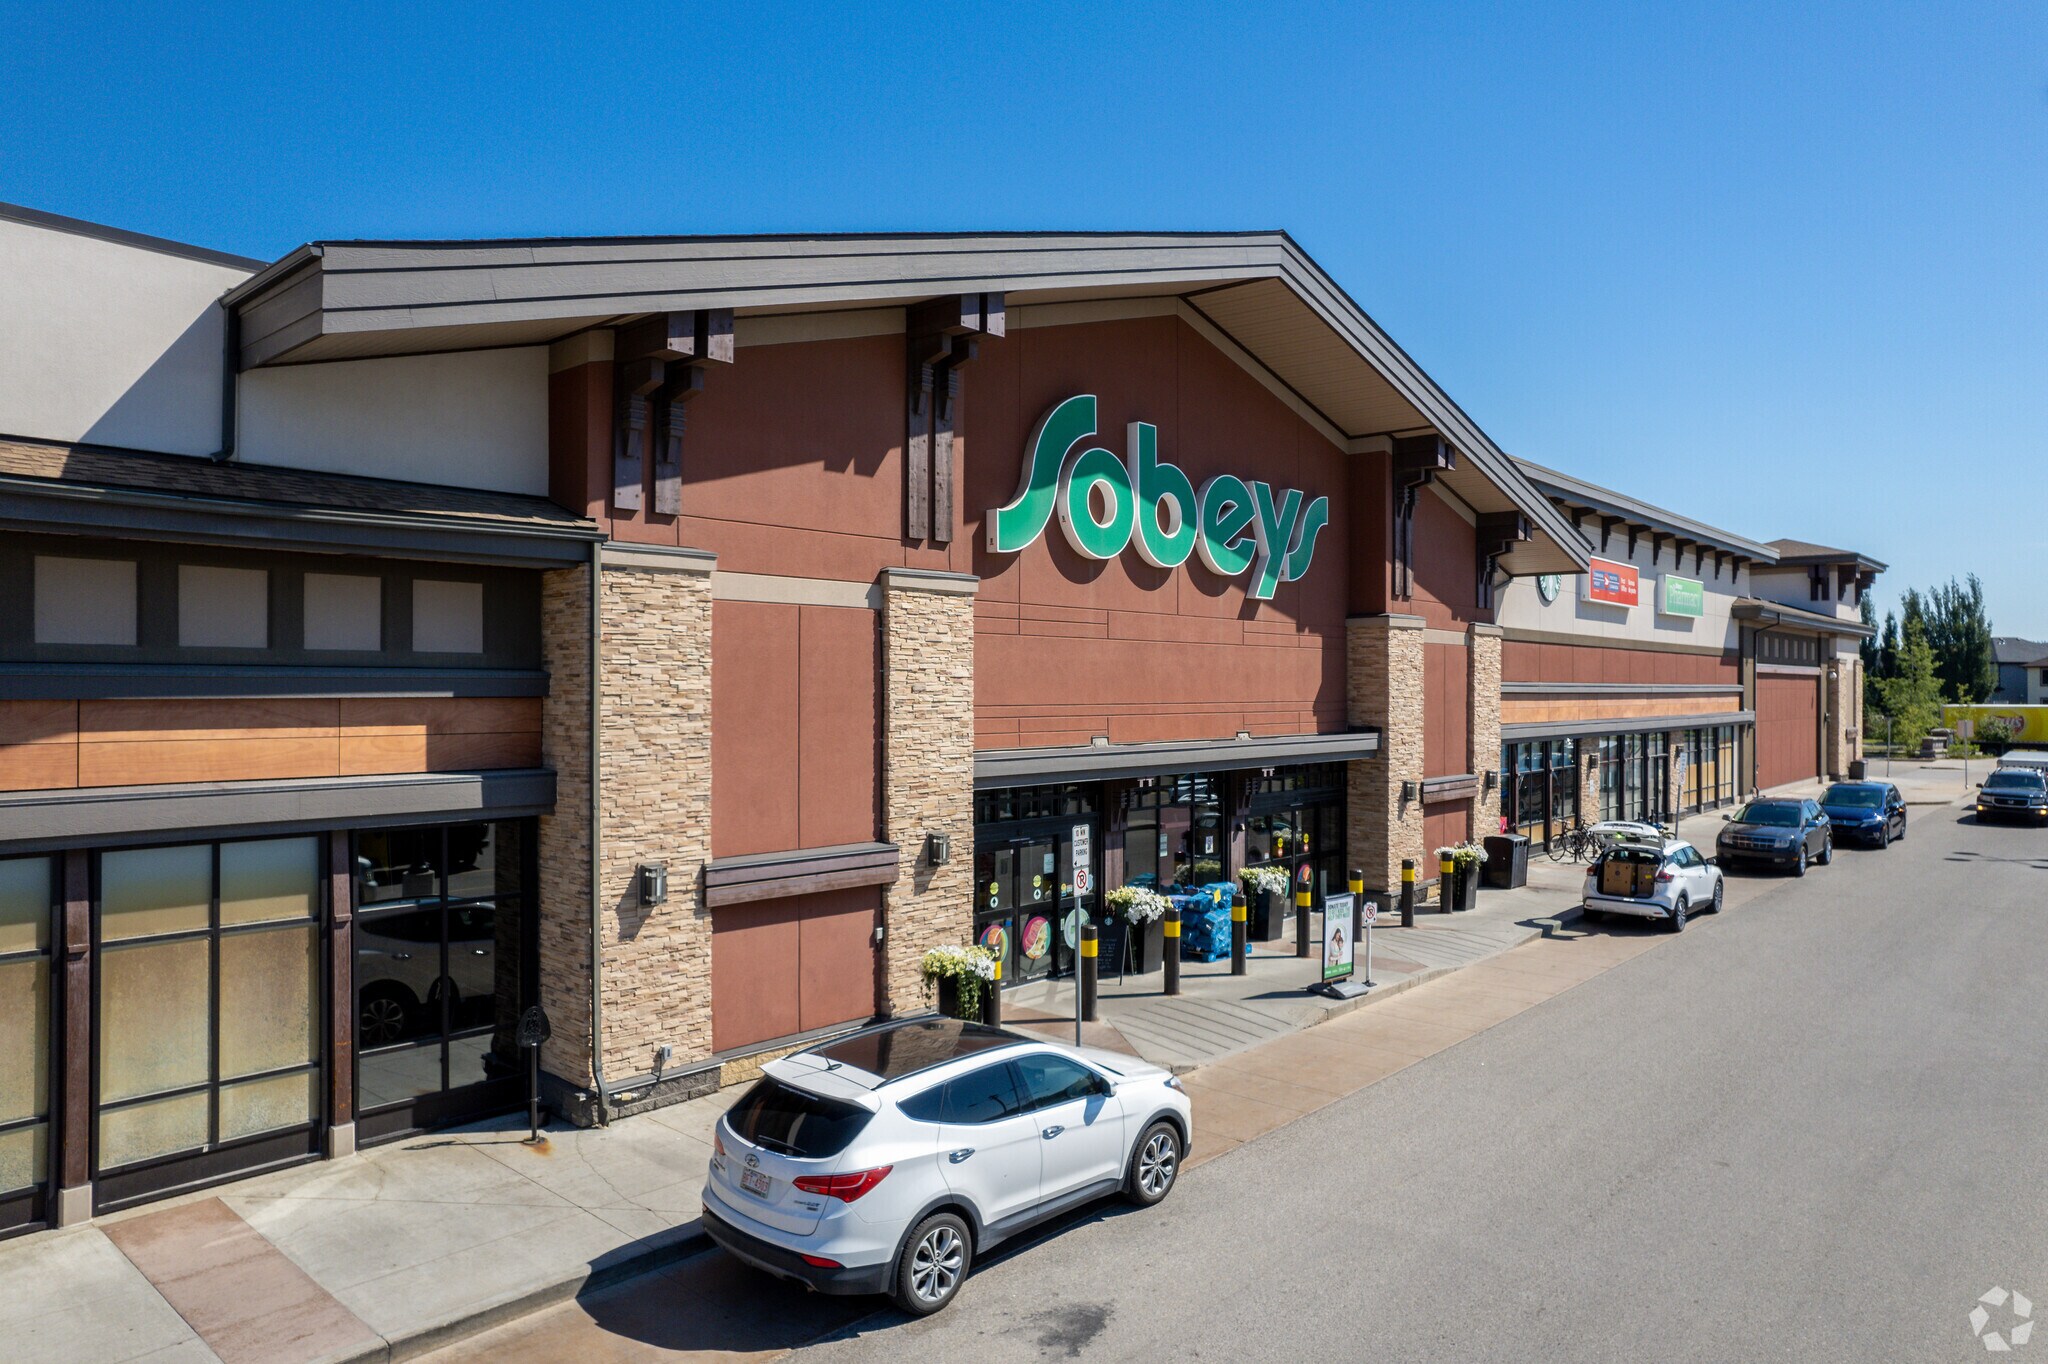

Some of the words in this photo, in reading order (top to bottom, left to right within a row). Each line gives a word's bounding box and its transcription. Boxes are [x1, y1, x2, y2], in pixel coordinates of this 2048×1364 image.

[986, 394, 1328, 600] Sobeys
[1074, 838, 1089, 847] CUSTOMER
[1075, 848, 1088, 857] PARKING
